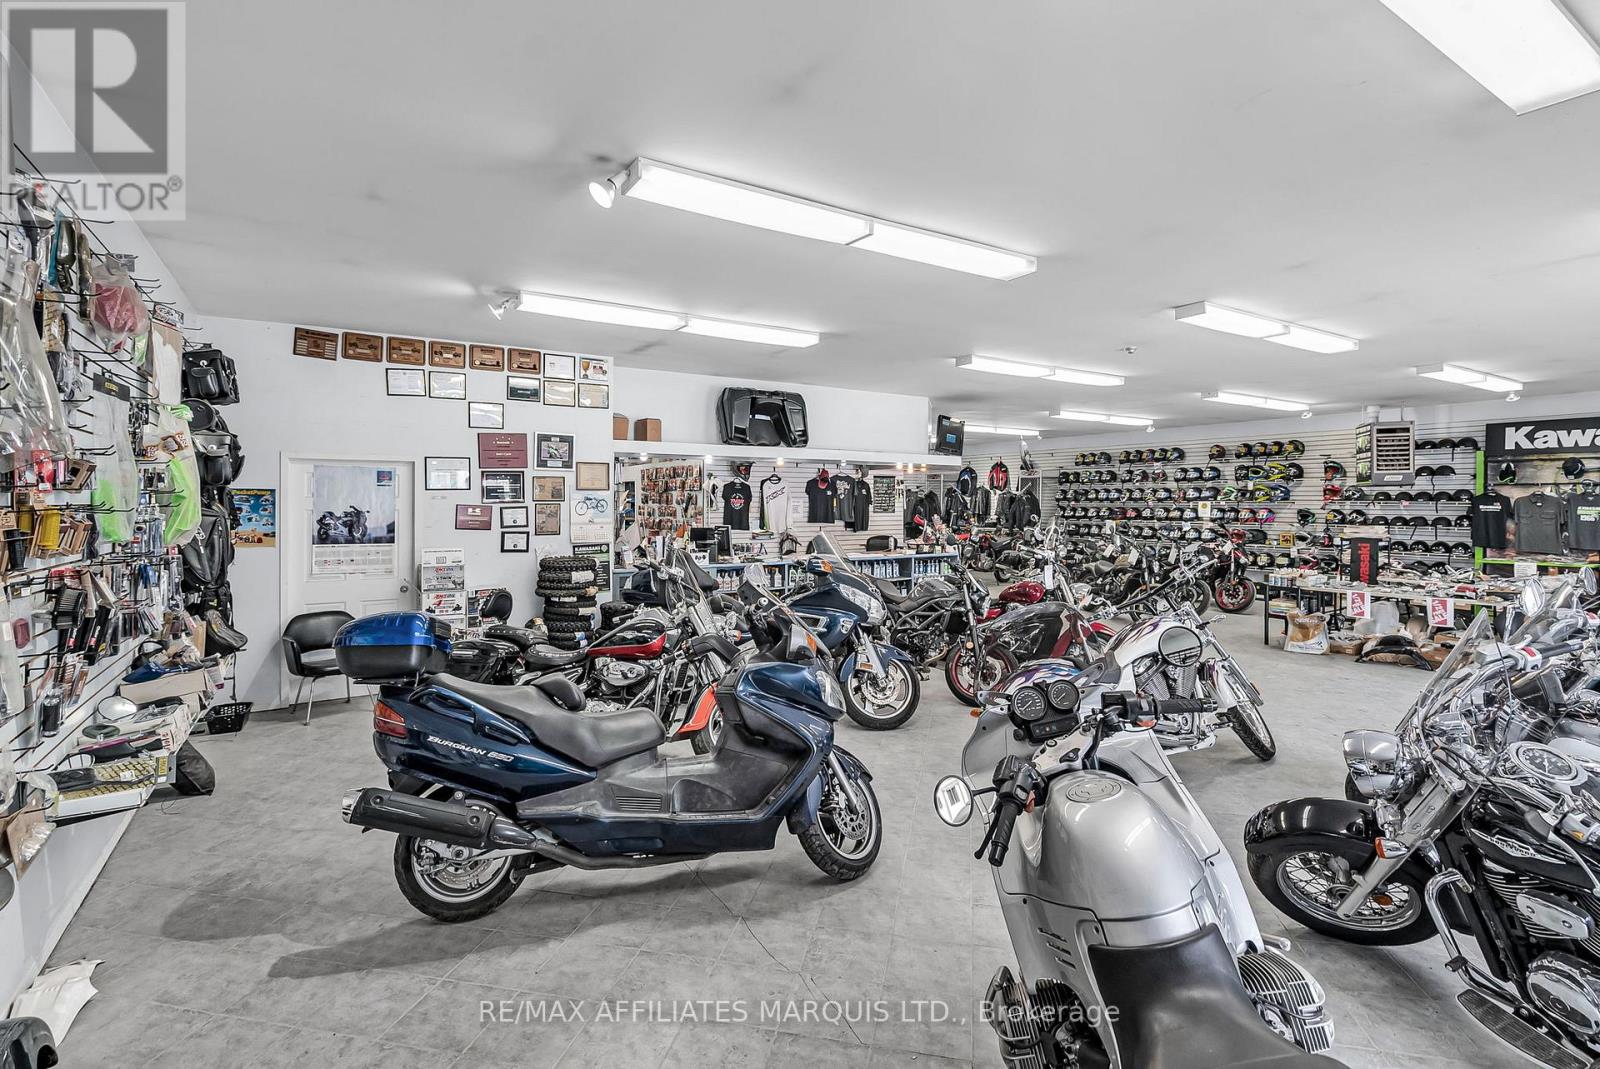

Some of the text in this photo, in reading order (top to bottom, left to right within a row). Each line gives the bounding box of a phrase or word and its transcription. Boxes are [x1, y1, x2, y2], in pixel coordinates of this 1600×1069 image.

[1504, 425, 1600, 450] Kaw
[427, 735, 515, 762] BURGMAN 650
